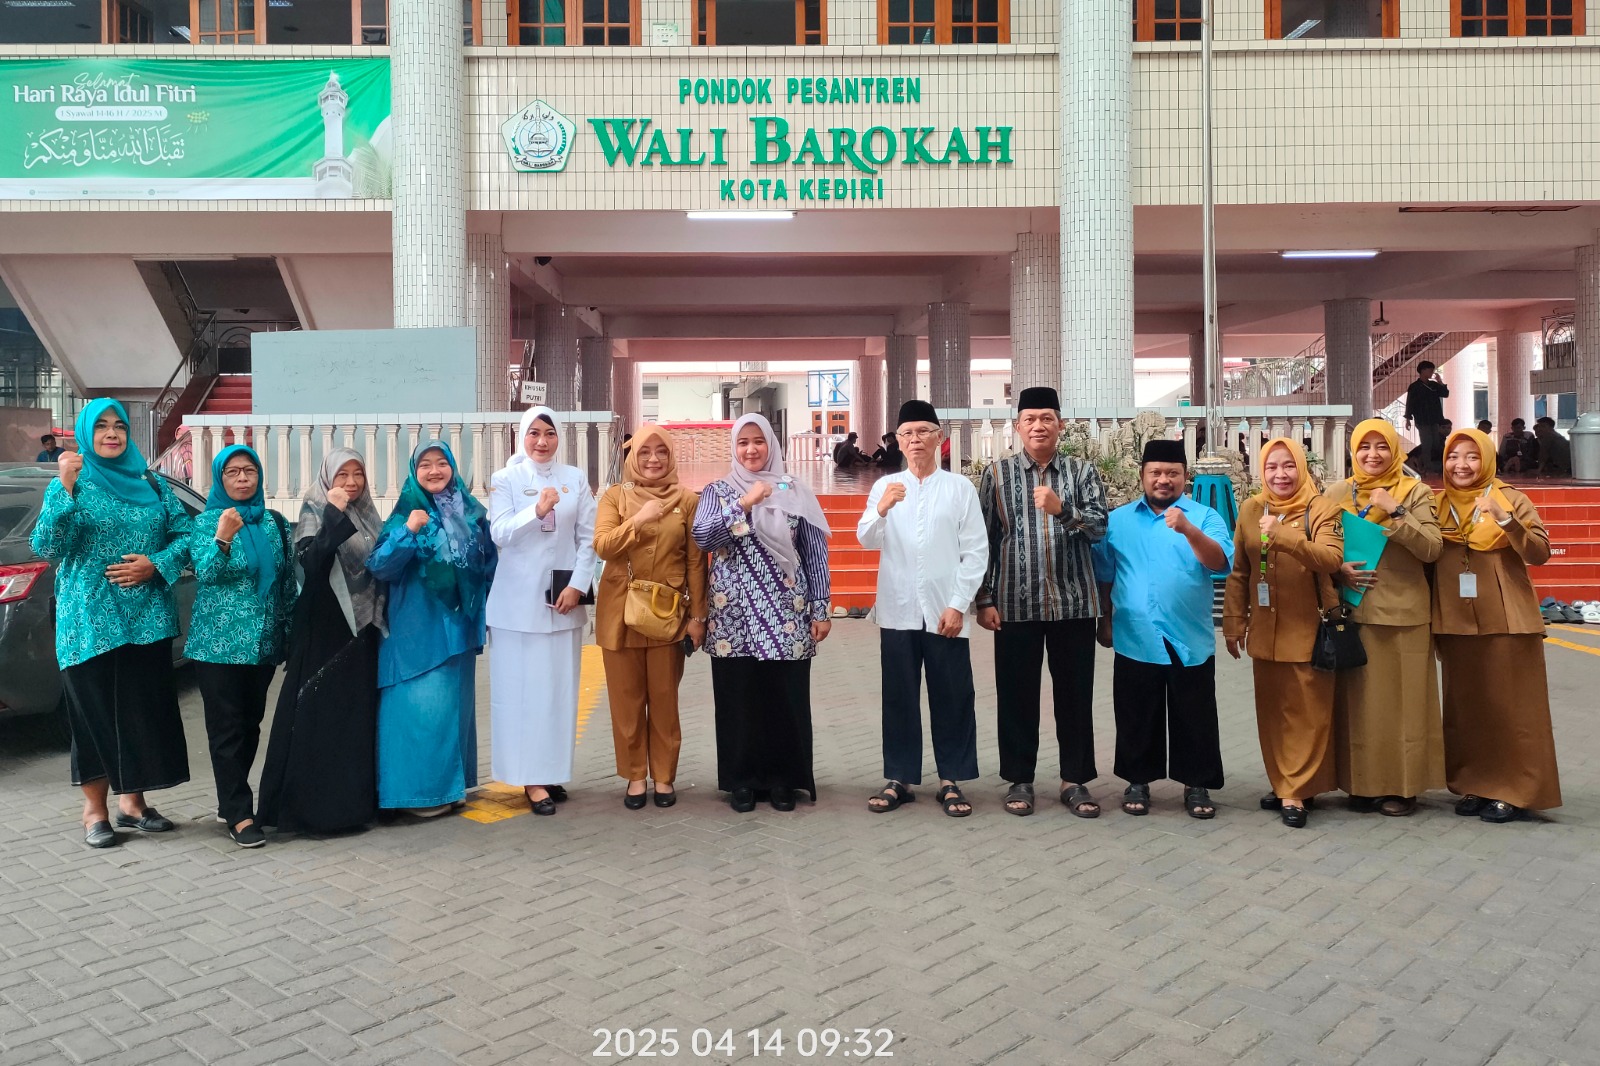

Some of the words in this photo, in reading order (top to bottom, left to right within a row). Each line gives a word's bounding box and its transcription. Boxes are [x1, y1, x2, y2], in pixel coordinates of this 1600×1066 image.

[73, 72, 140, 91] Selamat
[679, 78, 772, 104] PONDOK
[787, 77, 921, 104] PESANTREN
[13, 84, 55, 103] Hari
[60, 84, 108, 107] Raya
[113, 84, 150, 103] Idul
[155, 84, 197, 103] Fitri
[66, 110, 94, 118] Syawal
[587, 118, 727, 167] WALI
[750, 117, 1014, 174] BAROKAH
[721, 179, 788, 201] KOTA
[800, 178, 884, 201] KEDIRI
